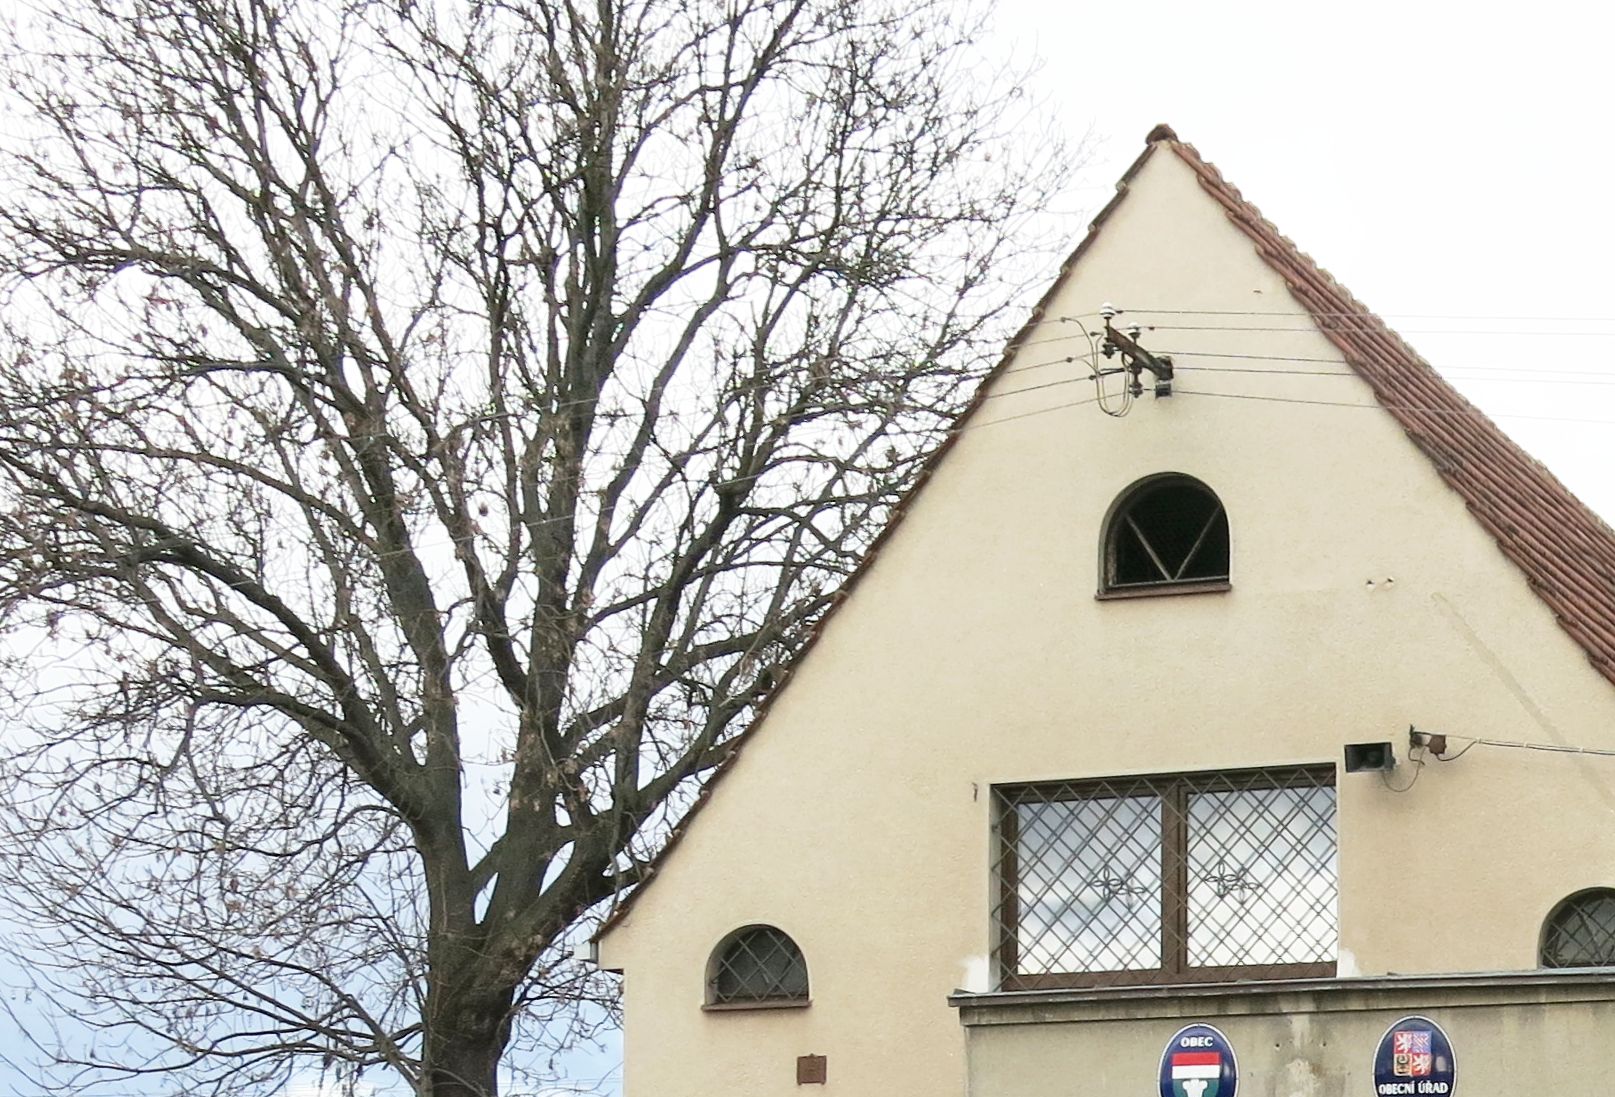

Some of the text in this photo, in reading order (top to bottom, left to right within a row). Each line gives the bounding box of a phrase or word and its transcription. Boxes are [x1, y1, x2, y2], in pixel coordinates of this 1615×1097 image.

[1180, 1036, 1214, 1048] OBEC
[1378, 1080, 1449, 1095] OBECNÍ ÚŘAD
